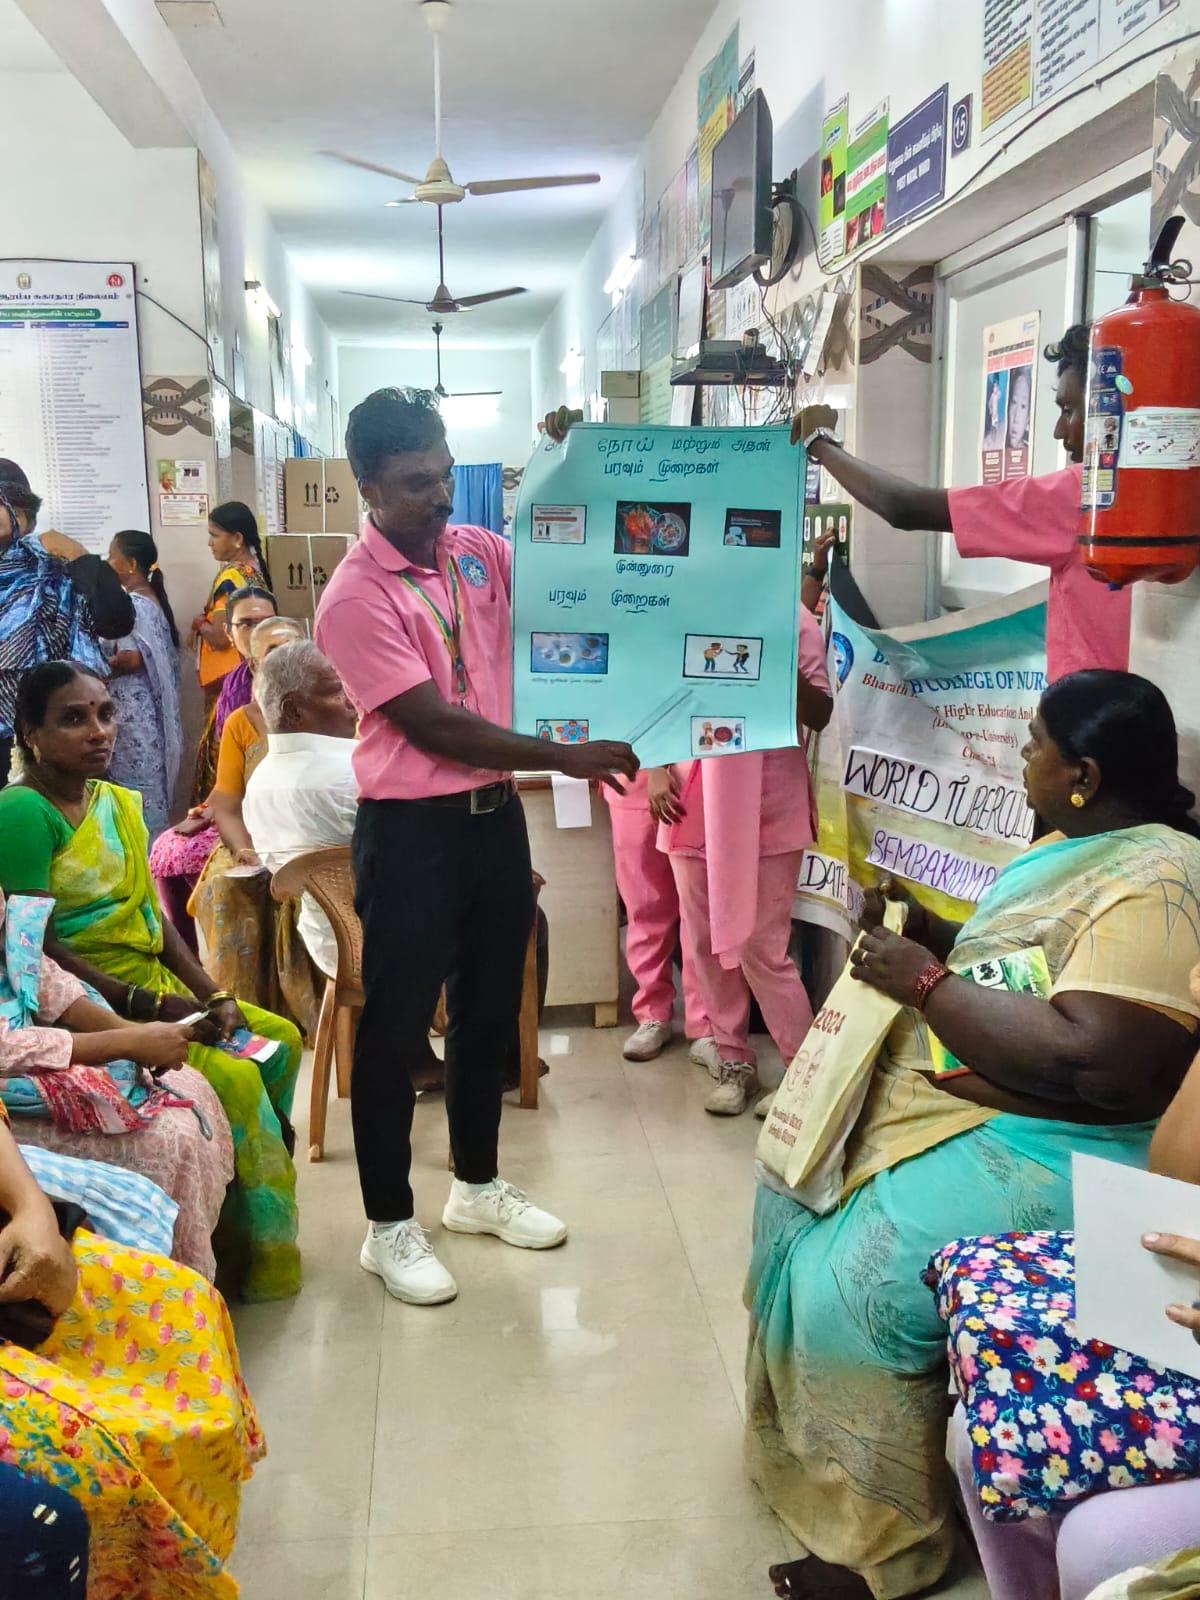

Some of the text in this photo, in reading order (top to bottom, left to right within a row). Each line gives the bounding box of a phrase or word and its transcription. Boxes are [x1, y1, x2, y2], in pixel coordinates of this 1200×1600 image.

[955, 114, 966, 139] 15
[604, 459, 720, 477] பரவும் முறைகள்
[549, 589, 671, 610] பரவும் முறைகள்
[862, 673, 908, 695] Bharath
[996, 671, 1015, 689] OF
[1017, 671, 1046, 691] NUR
[977, 704, 1017, 720] Education
[1018, 706, 1034, 720] And
[844, 750, 940, 813] WORLD
[813, 1008, 846, 1035] 2024
